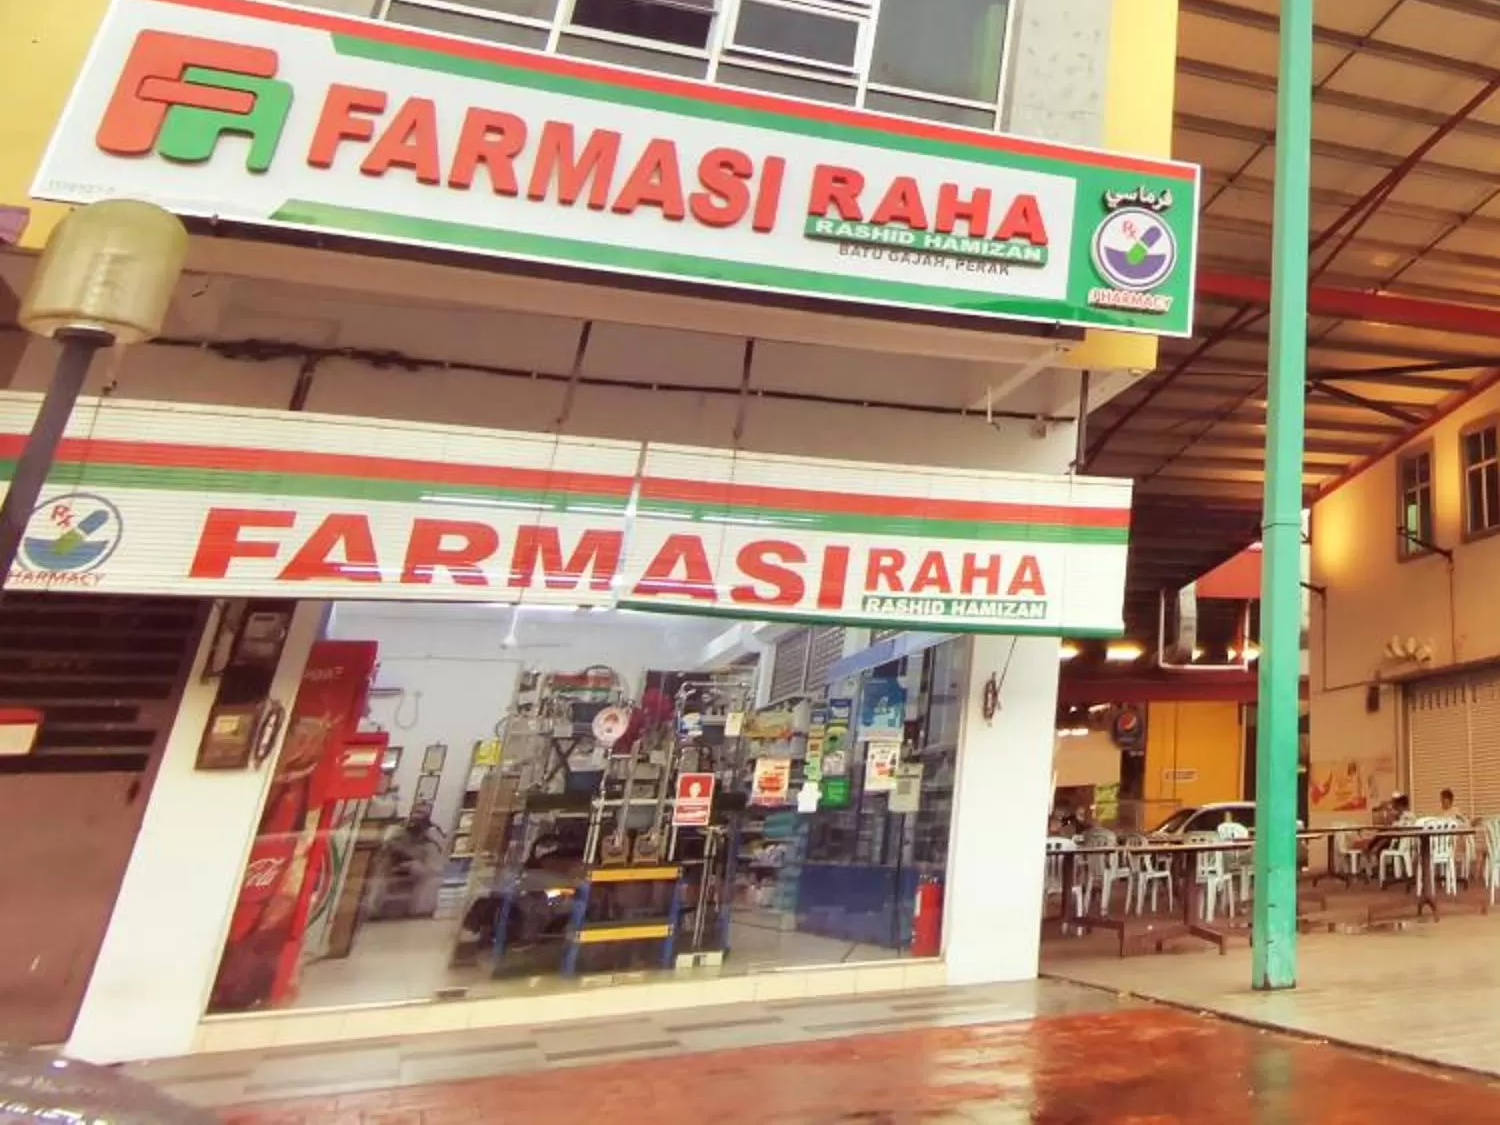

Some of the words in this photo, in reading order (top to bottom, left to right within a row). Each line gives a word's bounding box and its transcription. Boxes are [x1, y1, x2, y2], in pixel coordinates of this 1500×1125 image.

[306, 82, 786, 233] FARMASI
[807, 163, 1049, 246] RAHA
[815, 219, 916, 246] RASHID
[923, 231, 1042, 261] HAMIZAN
[838, 242, 882, 261] BATU
[955, 258, 1010, 276] PERAK
[1089, 288, 1172, 310] PHARMACY
[187, 506, 851, 609] FARMASI
[864, 547, 1047, 596] RAHA
[866, 597, 945, 616] RASHID
[952, 599, 1045, 619] HAMIZAN
